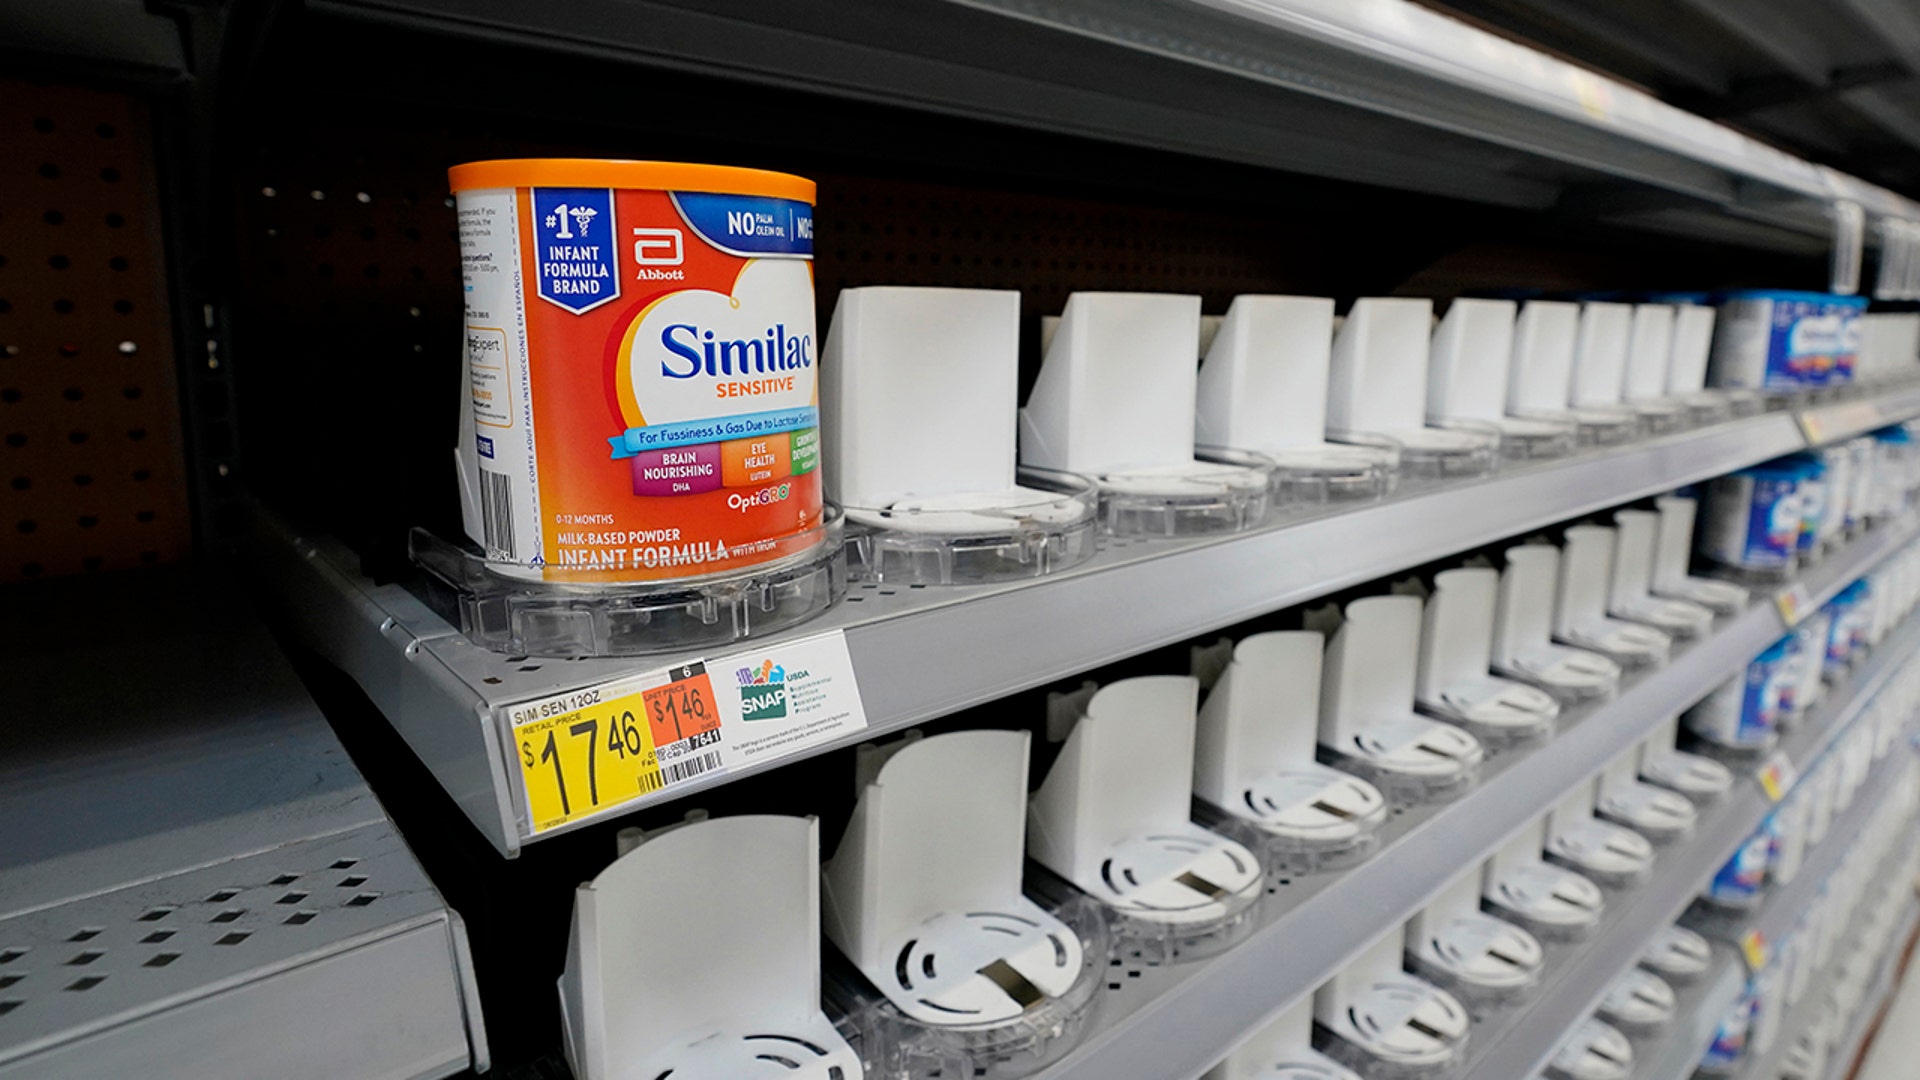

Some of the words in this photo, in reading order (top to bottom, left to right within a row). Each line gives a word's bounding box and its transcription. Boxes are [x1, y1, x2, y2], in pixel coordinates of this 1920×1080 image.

[546, 204, 573, 238] #1
[728, 211, 755, 236] NO
[756, 213, 773, 224] PALM
[756, 226, 774, 236] OLEIN
[775, 226, 785, 237] OIL
[550, 246, 599, 260] INFANT
[544, 263, 609, 278] FORMULA
[636, 270, 684, 280] Abbott
[553, 280, 600, 294] BRAND
[516, 313, 523, 328] EN
[662, 324, 810, 378] Similac
[518, 328, 529, 401] INSTRUCCIONES
[716, 376, 794, 398] SENSITIVE
[639, 432, 658, 444] For
[661, 426, 713, 441] Fussiness
[716, 424, 724, 435] &
[726, 422, 744, 434] Gas
[747, 419, 764, 430] Due
[764, 418, 774, 428] to
[752, 442, 766, 454] EYE
[662, 452, 696, 466] BRAIN
[744, 454, 775, 468] HEALTH
[644, 464, 714, 480] NOURISHING
[750, 470, 772, 481] LUTEIN
[673, 483, 690, 492] DHA
[728, 485, 789, 513] OptiGRO
[556, 514, 572, 524] 0-12
[574, 514, 614, 524] MONTHS
[558, 531, 626, 545] MILK-BASED
[629, 528, 680, 544] POWDER
[558, 548, 626, 570] INFANT
[633, 540, 729, 568] FORMULA
[683, 665, 692, 678] 6
[786, 670, 810, 682] USDA
[644, 691, 662, 702] UNIT
[664, 684, 686, 696] PRICE
[742, 690, 786, 714] SNAP
[514, 708, 538, 724] SIM
[541, 701, 568, 717] SEN
[522, 722, 554, 735] RETAIL
[556, 712, 582, 726] PRICE
